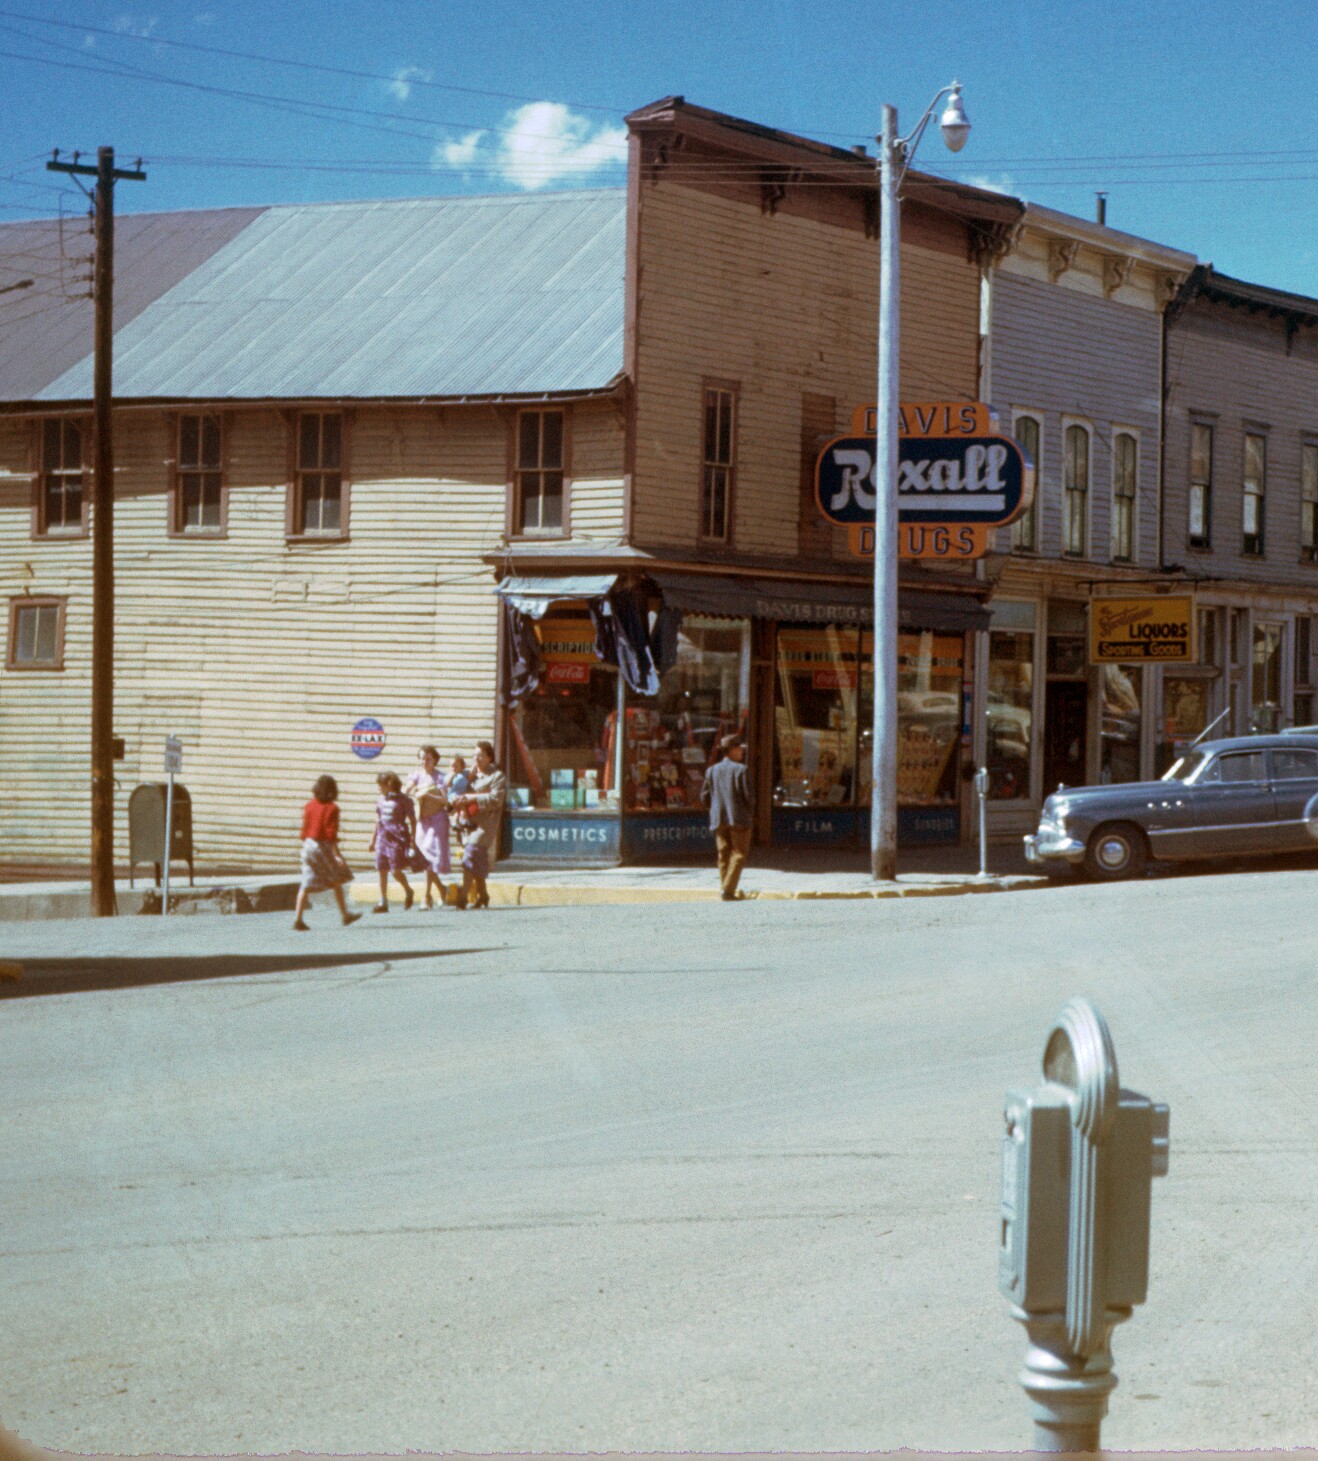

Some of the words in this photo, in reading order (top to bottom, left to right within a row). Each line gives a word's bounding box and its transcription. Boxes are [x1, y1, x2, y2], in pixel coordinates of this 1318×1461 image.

[859, 526, 975, 555] DUGS
[1129, 622, 1188, 639] LIQUORS
[644, 826, 712, 840] PRESCRIPTIO
[795, 820, 833, 832] FILM
[513, 827, 608, 842] COSMETICS
